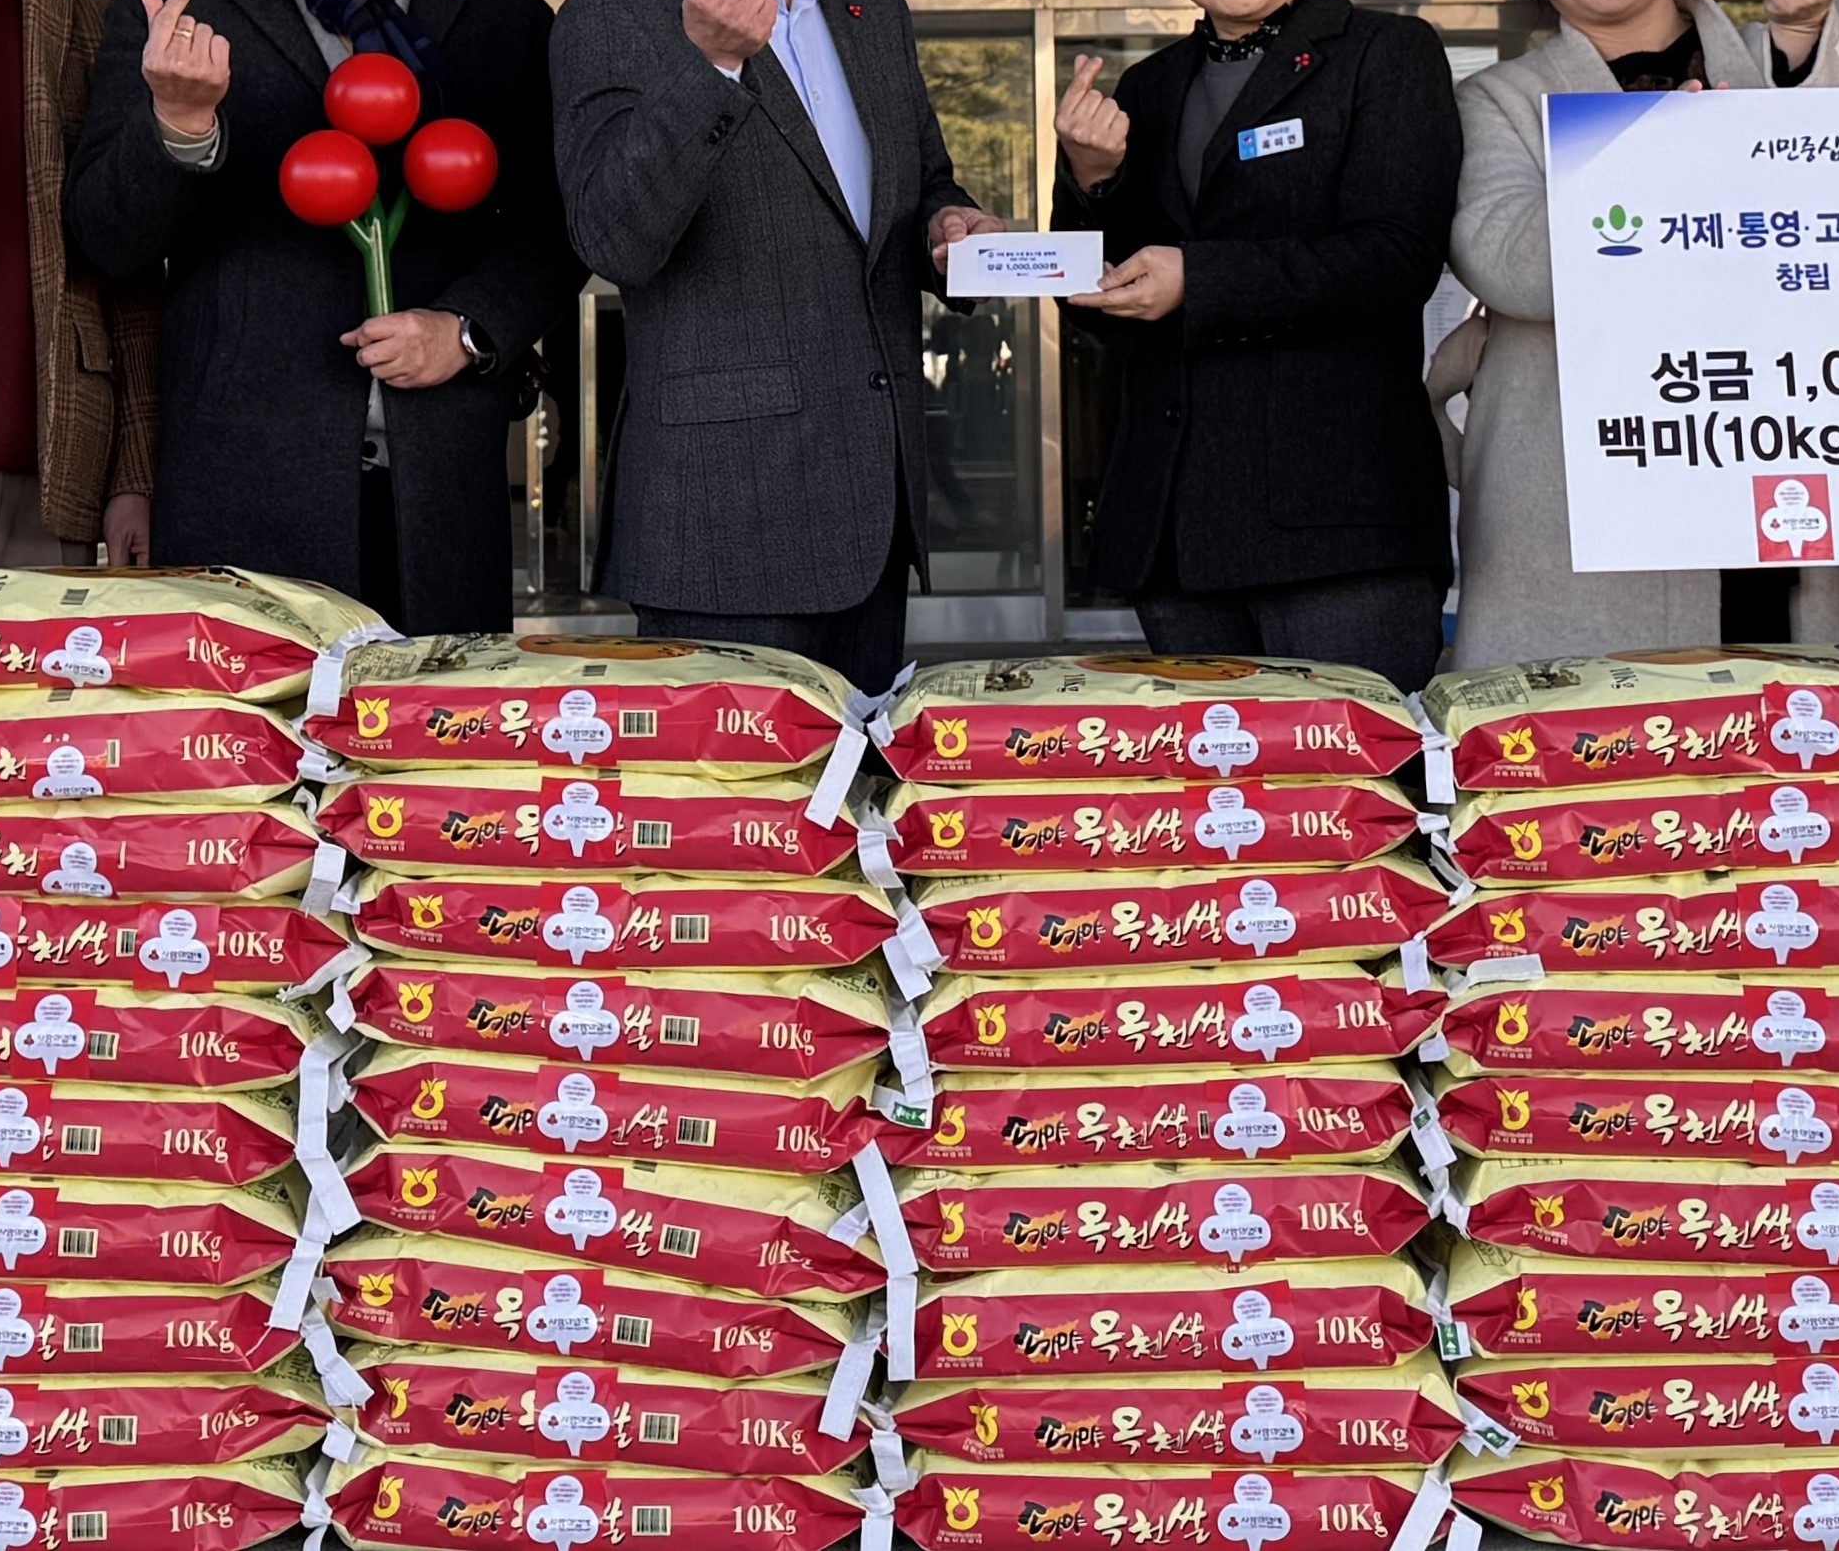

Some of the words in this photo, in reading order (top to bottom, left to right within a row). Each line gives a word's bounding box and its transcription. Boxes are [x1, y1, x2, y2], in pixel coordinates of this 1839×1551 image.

[1776, 261, 1831, 292] 창립
[1650, 349, 1754, 403] 성금
[188, 637, 245, 673] 10Kg
[717, 709, 778, 743] 10Kg
[1294, 723, 1362, 755] 10Kg
[182, 734, 246, 764] 10Kg
[732, 821, 799, 854] 10Kg
[1329, 891, 1397, 923] 10Kg
[770, 915, 832, 945] 10Kg
[218, 931, 284, 963] 10Kg
[180, 1032, 240, 1062] 10Kg
[1297, 1107, 1364, 1133] 10Kg
[1298, 1202, 1369, 1236] 10Kg
[161, 1230, 221, 1261] 10Kg
[166, 1320, 235, 1353] 10Kg
[1316, 1316, 1384, 1349] 10Kg
[1339, 1420, 1408, 1451] 10Kg
